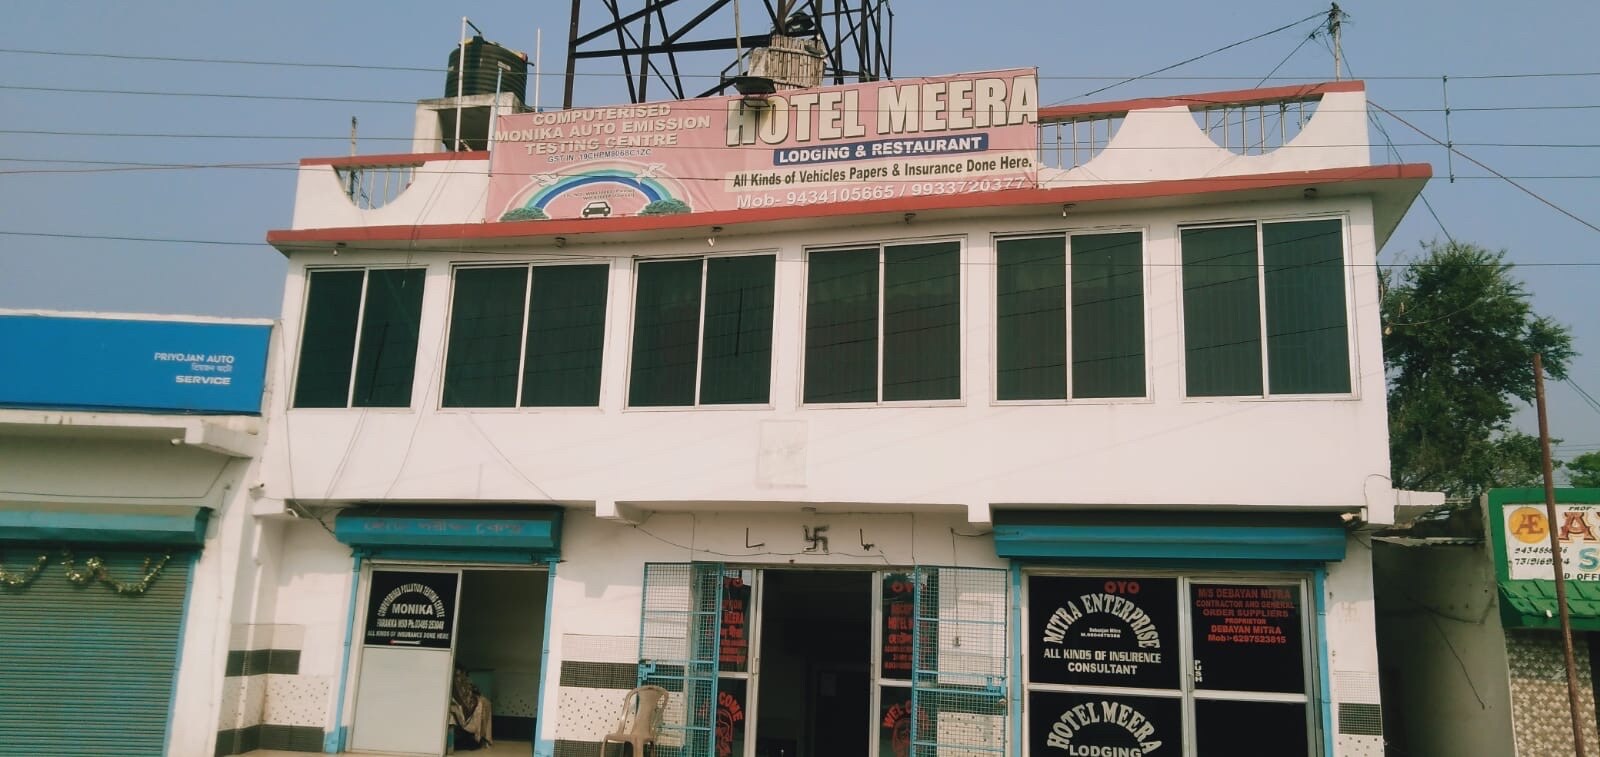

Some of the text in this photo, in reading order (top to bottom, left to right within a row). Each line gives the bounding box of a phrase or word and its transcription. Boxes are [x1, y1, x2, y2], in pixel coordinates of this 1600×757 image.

[533, 104, 672, 126] COMPUTERISED
[726, 73, 1039, 147] HOTEL MEERA
[494, 115, 711, 142] MONIKA AUTO EMISSION
[525, 133, 679, 156] TESTING CENTRE
[779, 136, 983, 164] LODGING & RESTAURANT
[733, 155, 1033, 187] All Kinds of Vehicles Papers & Insurance Done Here.
[736, 193, 780, 208] Mob-
[786, 185, 895, 205] 9434105665
[911, 176, 1027, 196] 9933720377
[154, 352, 235, 364] PRIYOJAN AUTO
[176, 375, 232, 385] SERVICE
[1104, 580, 1141, 594] OYO
[1216, 588, 1258, 599] DEBAYAN
[1261, 588, 1292, 599] MITRA
[391, 603, 434, 616] MONIKA
[1203, 608, 1289, 617] ORDER SUPPLIERS
[1043, 593, 1161, 649] MITRA ENTERPRISE
[1211, 624, 1282, 635] DEBAYAN MITRA
[1043, 648, 1162, 664] ALL KINDS OF INSURENCE
[1067, 662, 1138, 675] CONSULTANT
[1046, 700, 1163, 755] HOTEL MEERA
[1069, 744, 1142, 757] LODGING
